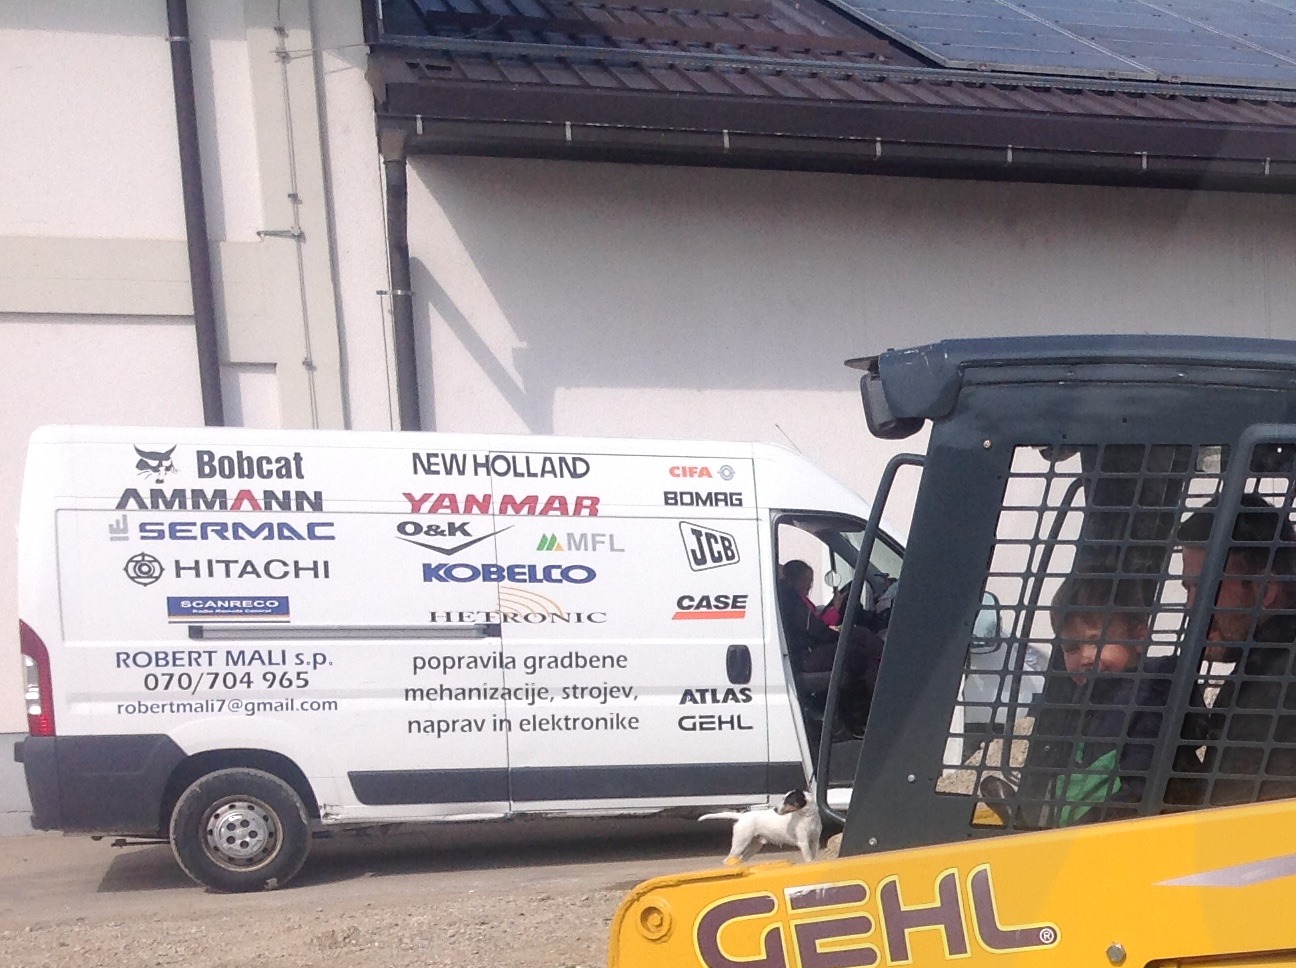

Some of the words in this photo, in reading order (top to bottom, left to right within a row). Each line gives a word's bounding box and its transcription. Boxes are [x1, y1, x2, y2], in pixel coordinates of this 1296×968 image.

[195, 450, 305, 480] Bobcat
[412, 453, 467, 476] NEW
[473, 454, 591, 479] HOLLAND
[668, 466, 713, 479] CIFA
[115, 488, 323, 512] AMMANN
[663, 491, 743, 507] BOMAG
[139, 522, 336, 541] SERMAC
[396, 521, 473, 537] O&K
[566, 532, 626, 553] MFL
[690, 528, 736, 566] JCB
[174, 558, 331, 580] HITACHI
[422, 563, 597, 585] KOBELCO
[180, 600, 279, 608] SCANRECO
[676, 594, 748, 611] CASE
[429, 611, 608, 625] HETRONIC
[116, 650, 218, 669] ROBERT
[225, 650, 288, 667] MALI
[294, 652, 334, 671] s.p.
[412, 652, 516, 675] popravila
[523, 651, 628, 674] gradbene
[144, 671, 255, 696] 070/704
[262, 670, 310, 690] 965
[404, 684, 555, 704] mehanizacije,
[561, 683, 640, 702] strojev,
[117, 697, 338, 717] robertmali7@gmail.com
[678, 688, 753, 705] ATLAS
[408, 715, 486, 737] naprav
[493, 714, 513, 732] in
[520, 712, 640, 733] elektronike
[678, 714, 753, 731] GEHL
